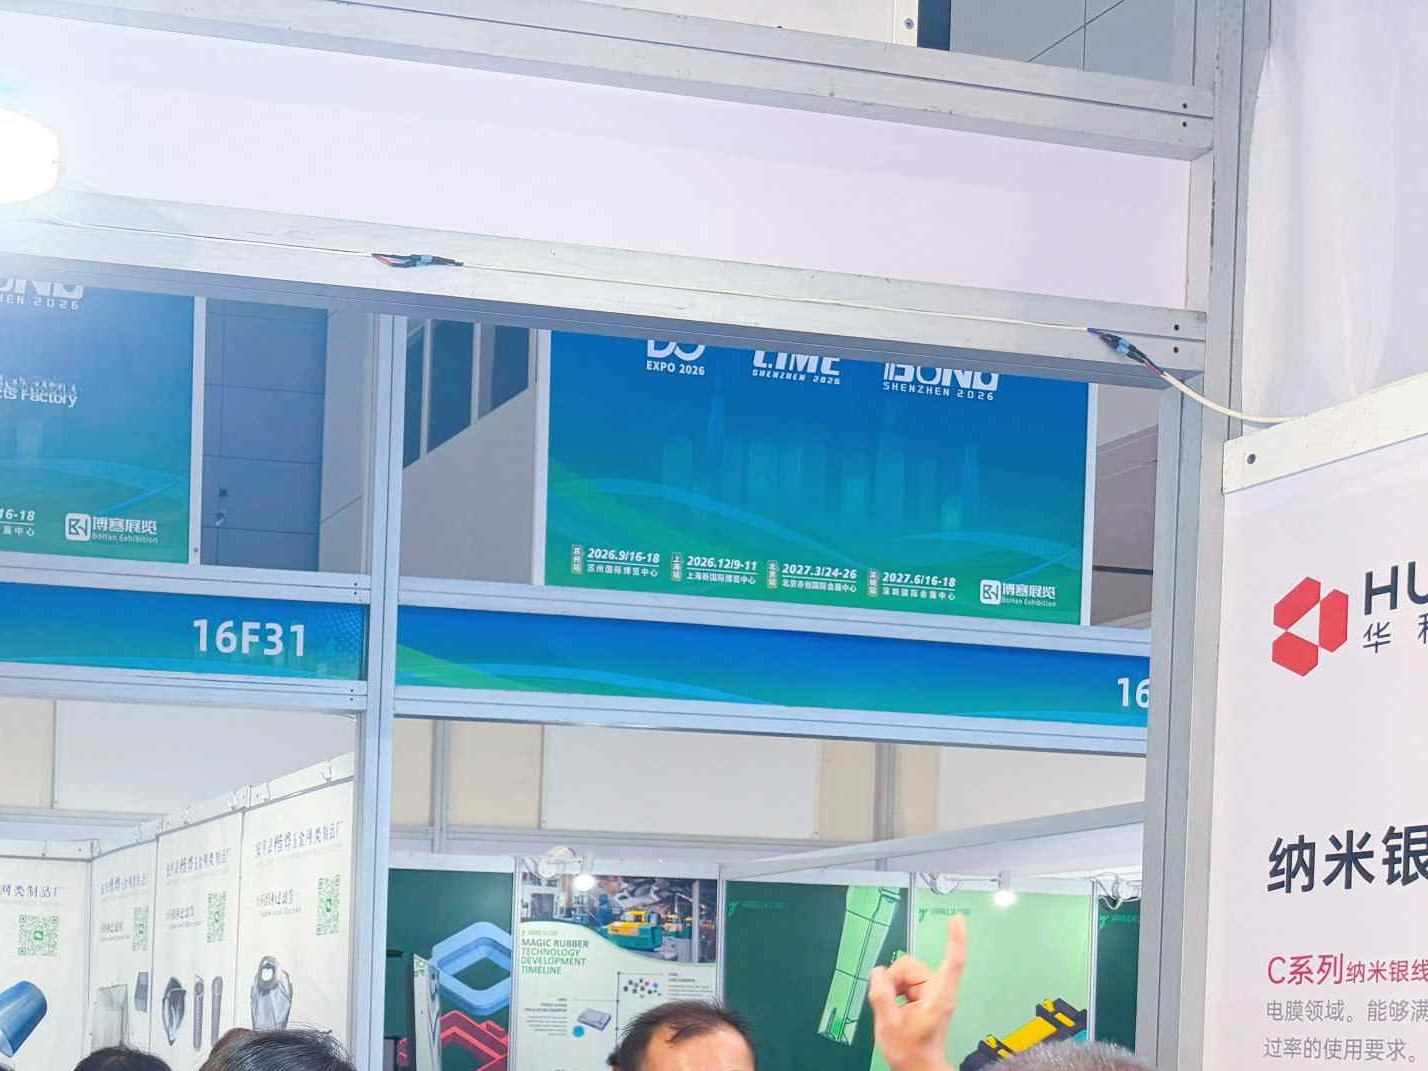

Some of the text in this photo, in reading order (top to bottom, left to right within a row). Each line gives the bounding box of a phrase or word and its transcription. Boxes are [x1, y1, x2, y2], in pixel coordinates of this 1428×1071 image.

[33, 297, 79, 310] 2026
[646, 360, 706, 376] EXPO 2026
[752, 369, 841, 385] SHENZHEN 2026
[883, 381, 994, 401] SHENZHEN 2026
[587, 548, 660, 564] 2026.9/16-18
[686, 555, 757, 572] 2026.12/9-11
[782, 563, 857, 579] 2027.3/24-26
[882, 571, 956, 588] 2027.6/16-18
[193, 618, 304, 657] 16F31
[1267, 825, 1428, 893] 纳米银
[521, 938, 589, 948] MAGIC RUBBER
[521, 947, 579, 957] TECHNOLOGY
[521, 956, 587, 966] DEVELOPMENT
[1267, 953, 1428, 985] C系列纳米银线
[521, 966, 562, 975] TIMELINE
[1263, 1037, 1416, 1063] 过率的使用要求。
